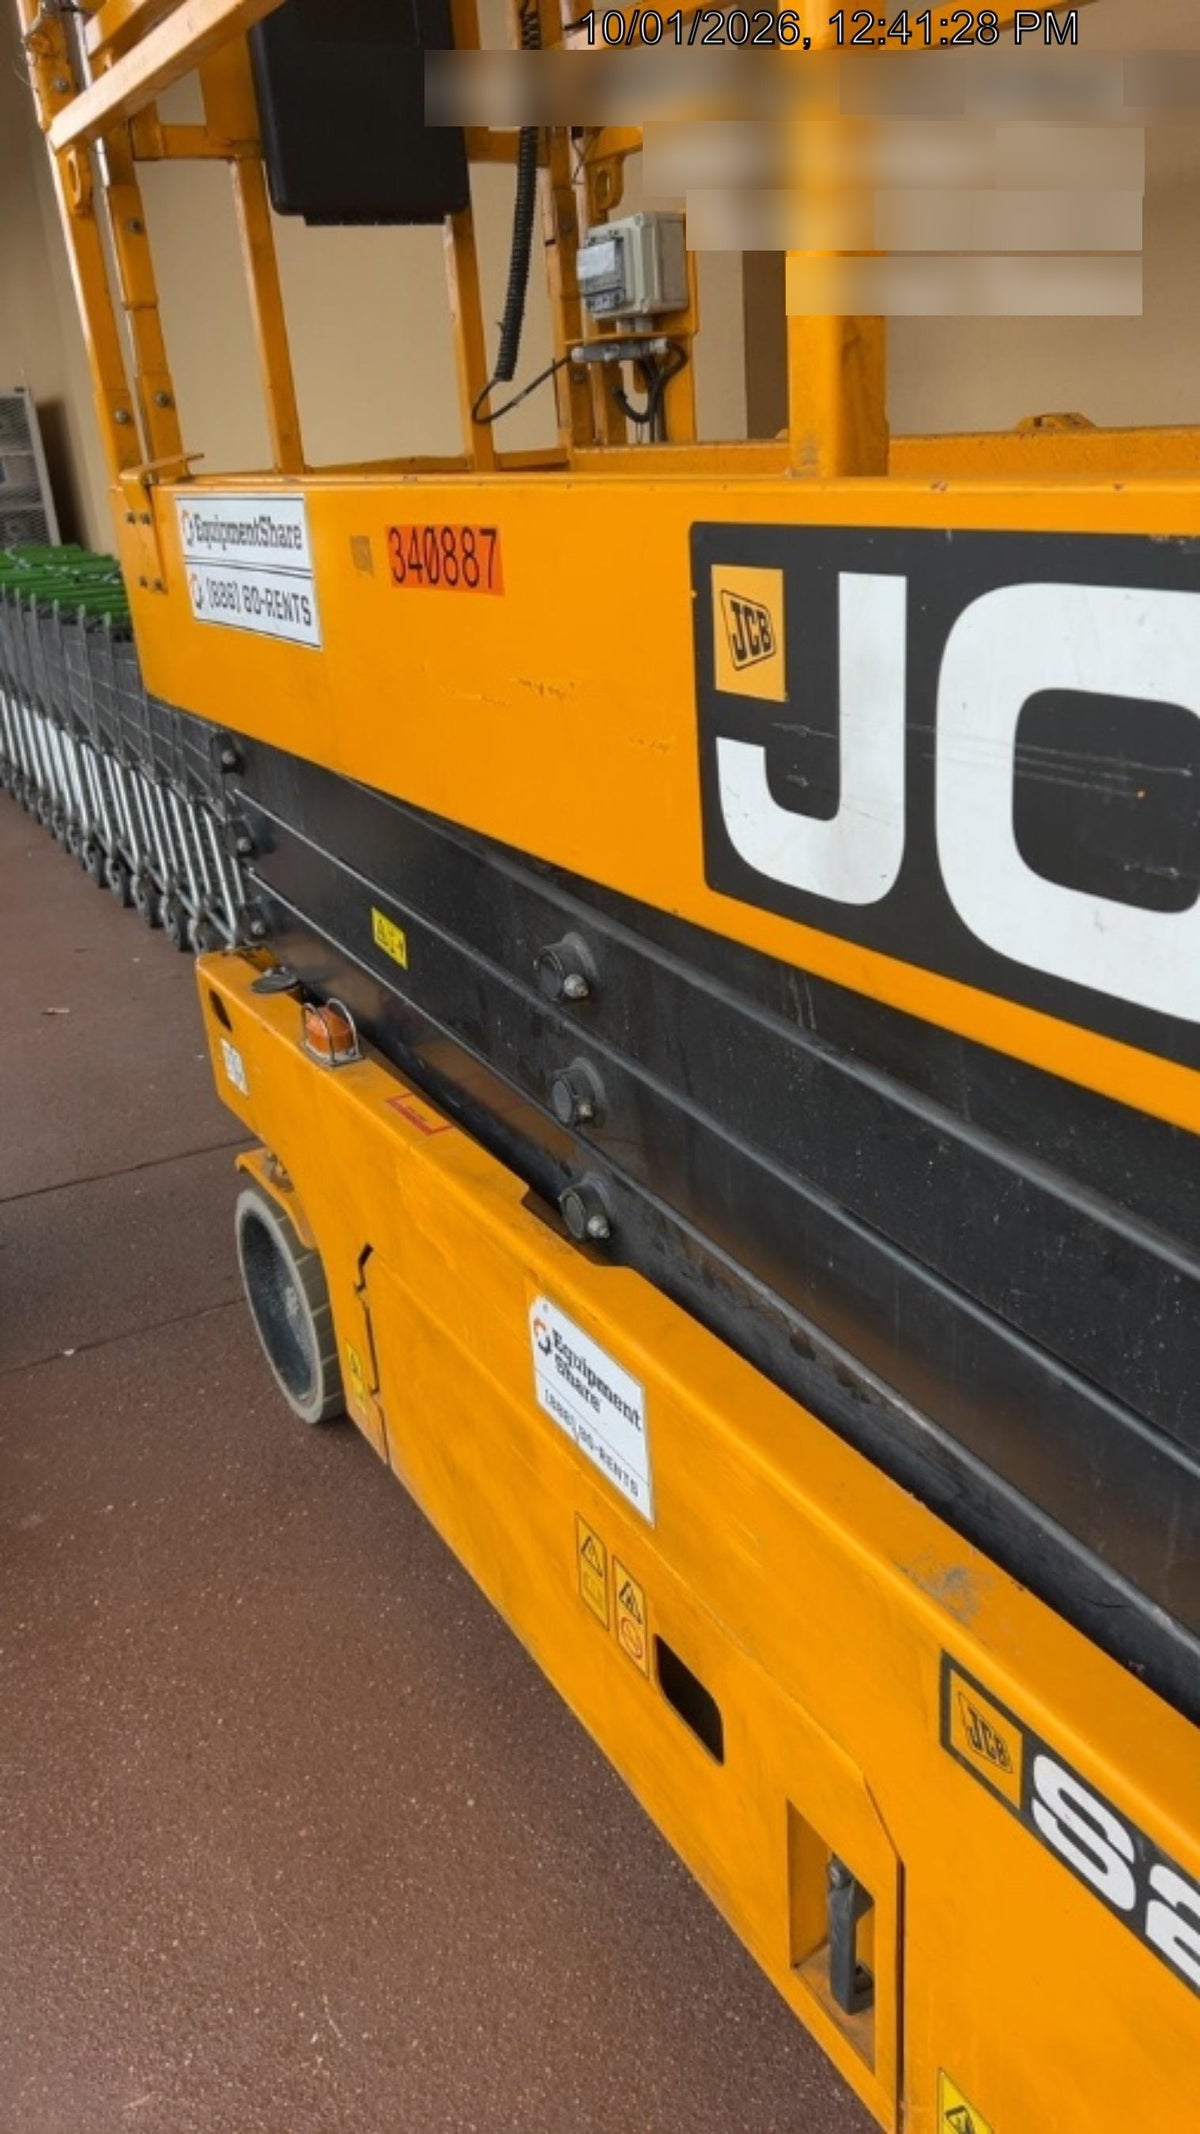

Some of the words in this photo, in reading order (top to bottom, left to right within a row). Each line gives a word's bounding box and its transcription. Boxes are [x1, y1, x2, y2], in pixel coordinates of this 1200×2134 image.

[193, 513, 303, 551] EquipmentShare
[388, 526, 497, 589] 340887
[730, 599, 772, 662] JCB
[551, 1328, 641, 1432] Equipment
[554, 1352, 600, 1414] Share
[967, 1704, 1009, 1768] JCB
